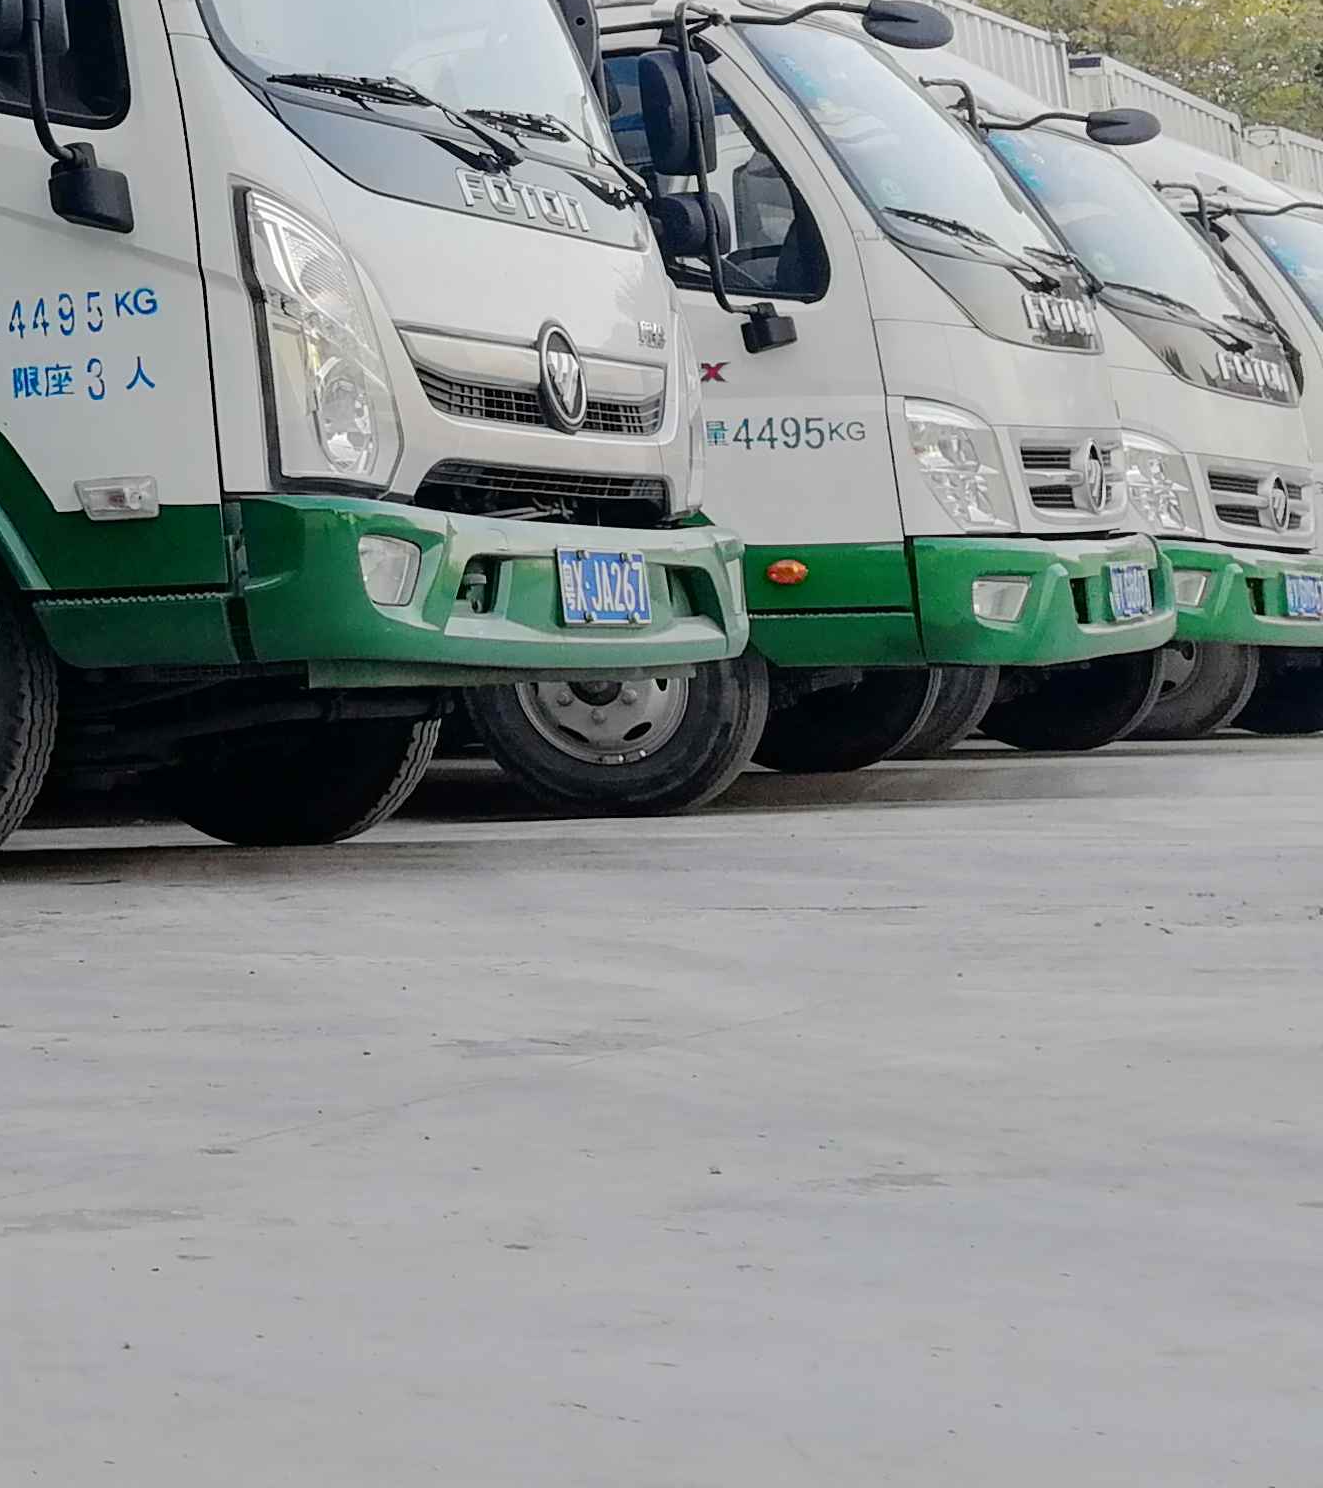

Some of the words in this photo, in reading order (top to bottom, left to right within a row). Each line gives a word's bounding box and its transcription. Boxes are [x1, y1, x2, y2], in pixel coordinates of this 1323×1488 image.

[456, 167, 590, 233] FOTON
[12, 365, 74, 399] 限座
[87, 358, 106, 401] 3
[125, 356, 155, 391] 人
